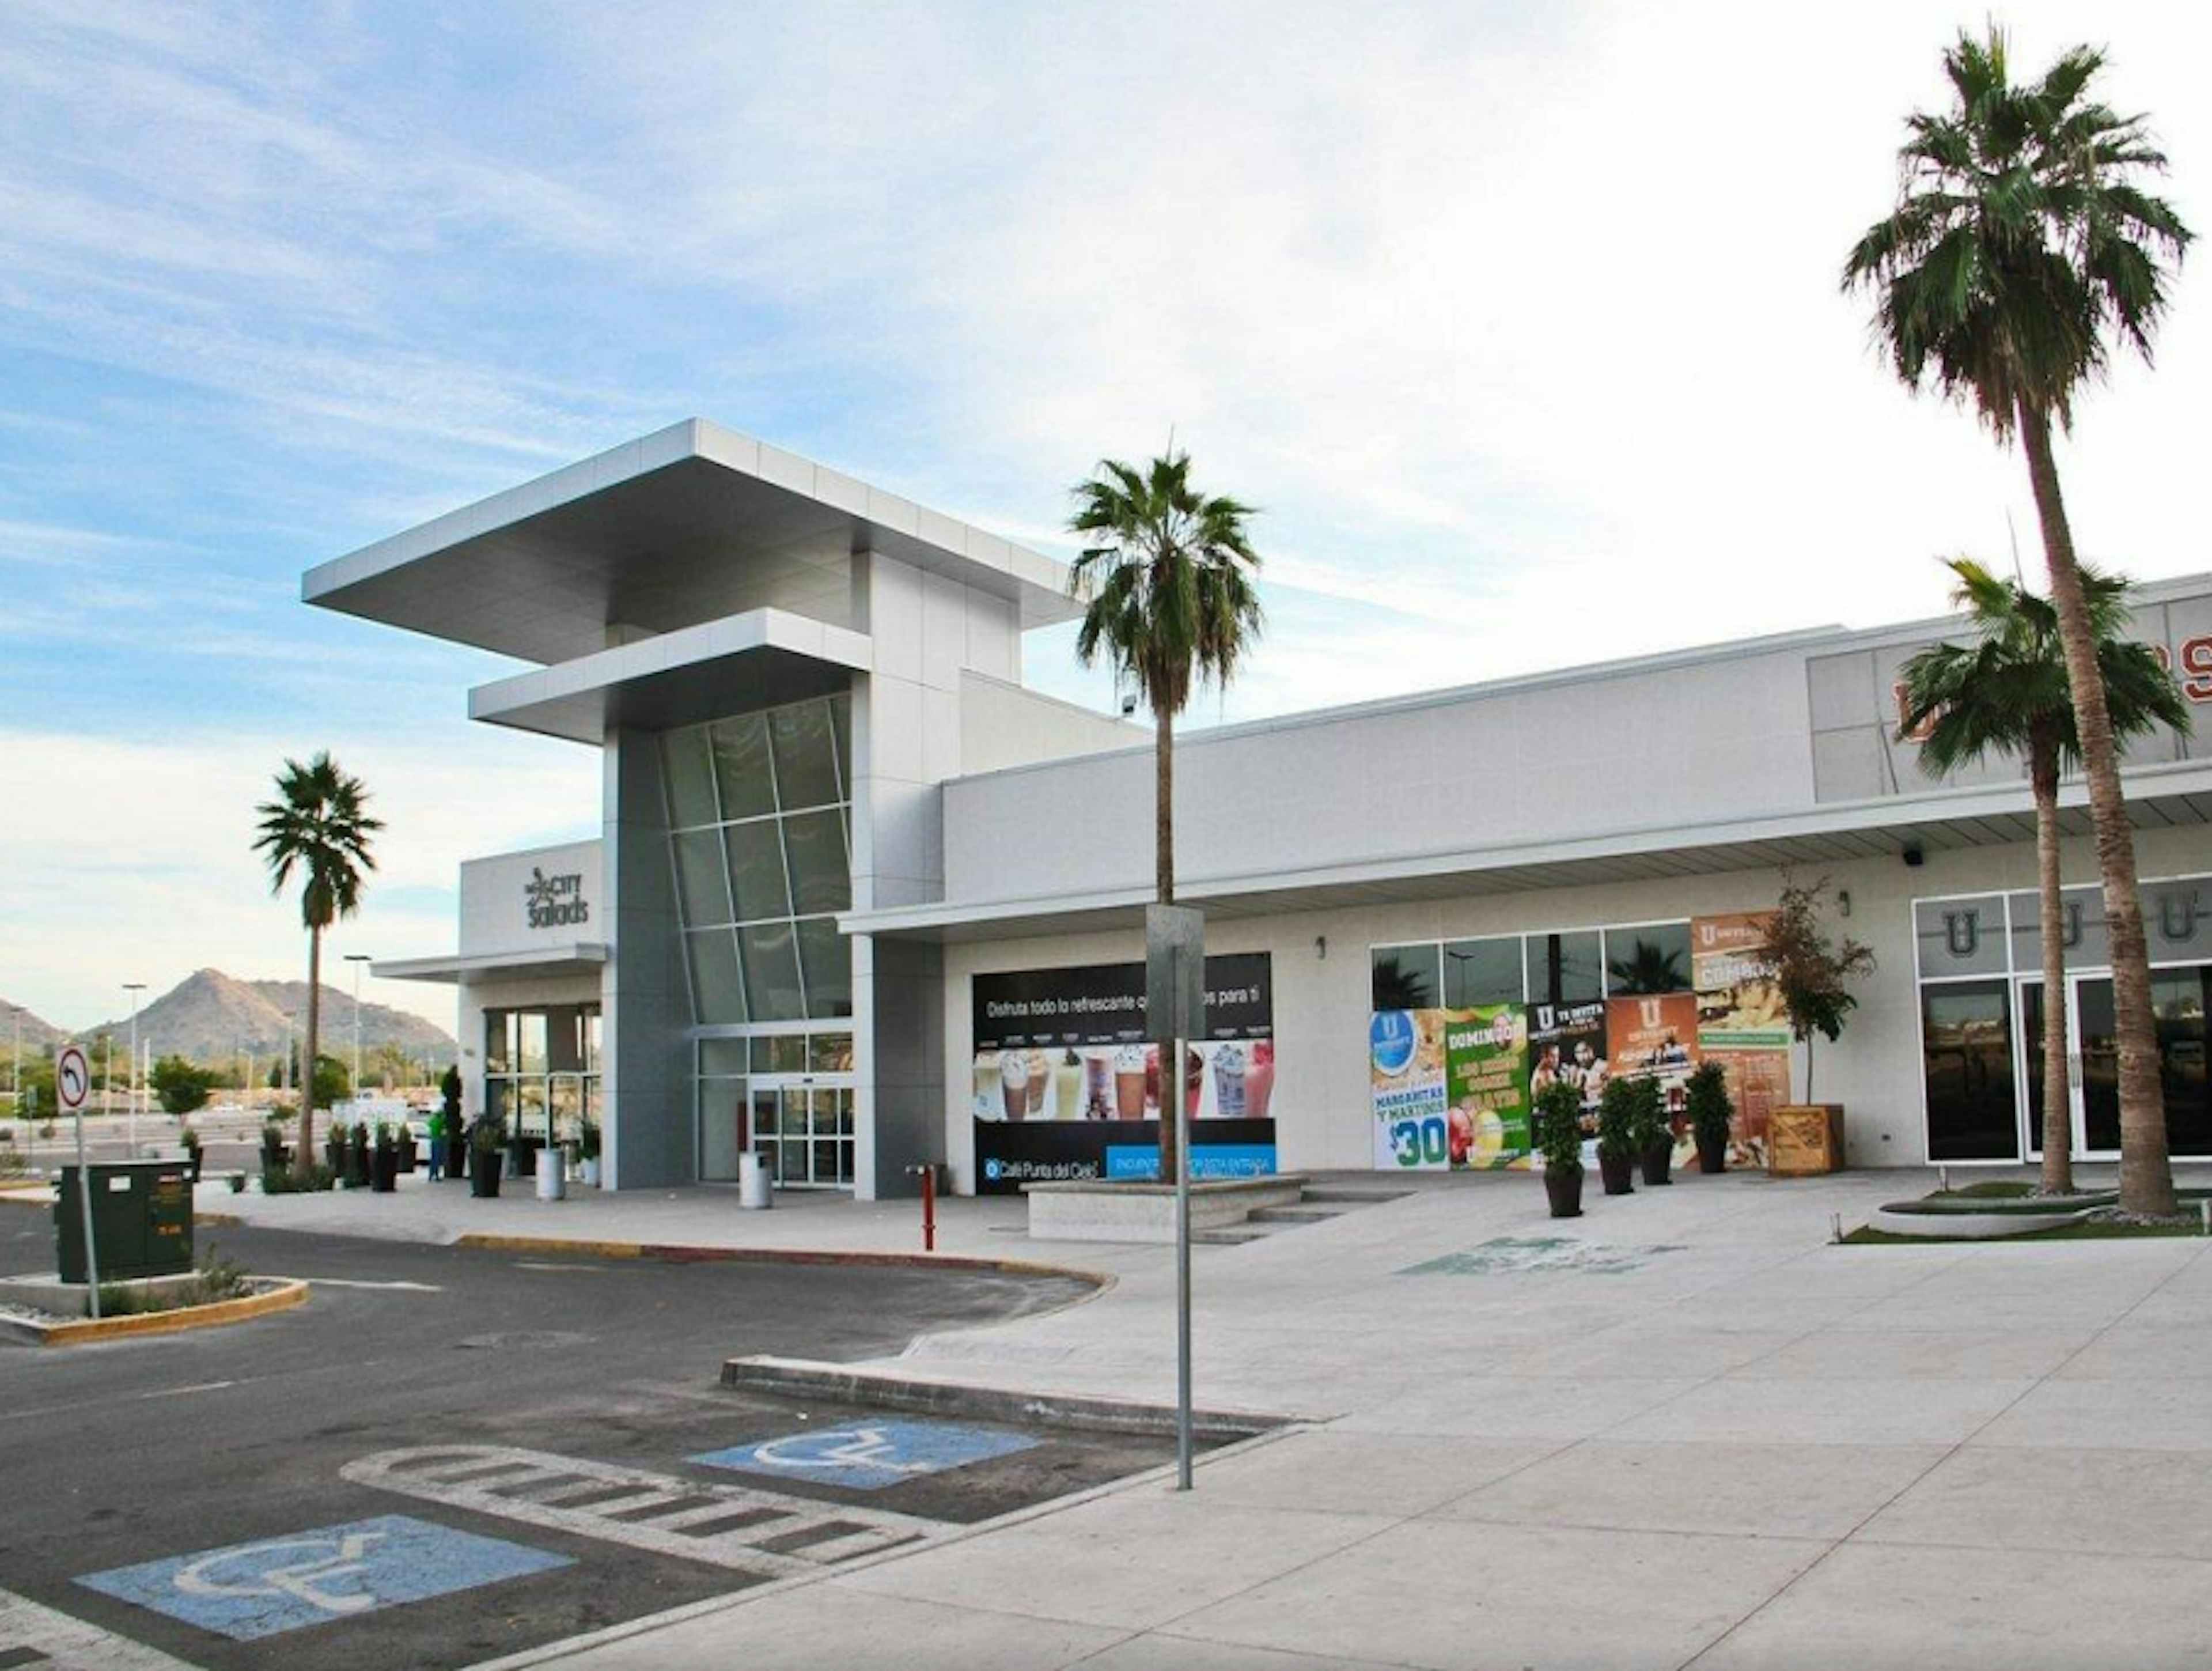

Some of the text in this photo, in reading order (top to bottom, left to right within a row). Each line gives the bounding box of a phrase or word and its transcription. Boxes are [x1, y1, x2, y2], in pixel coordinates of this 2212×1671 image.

[1943, 909, 1979, 958] U
[1030, 999, 1056, 1015] todo
[1218, 988, 1248, 1007] para
